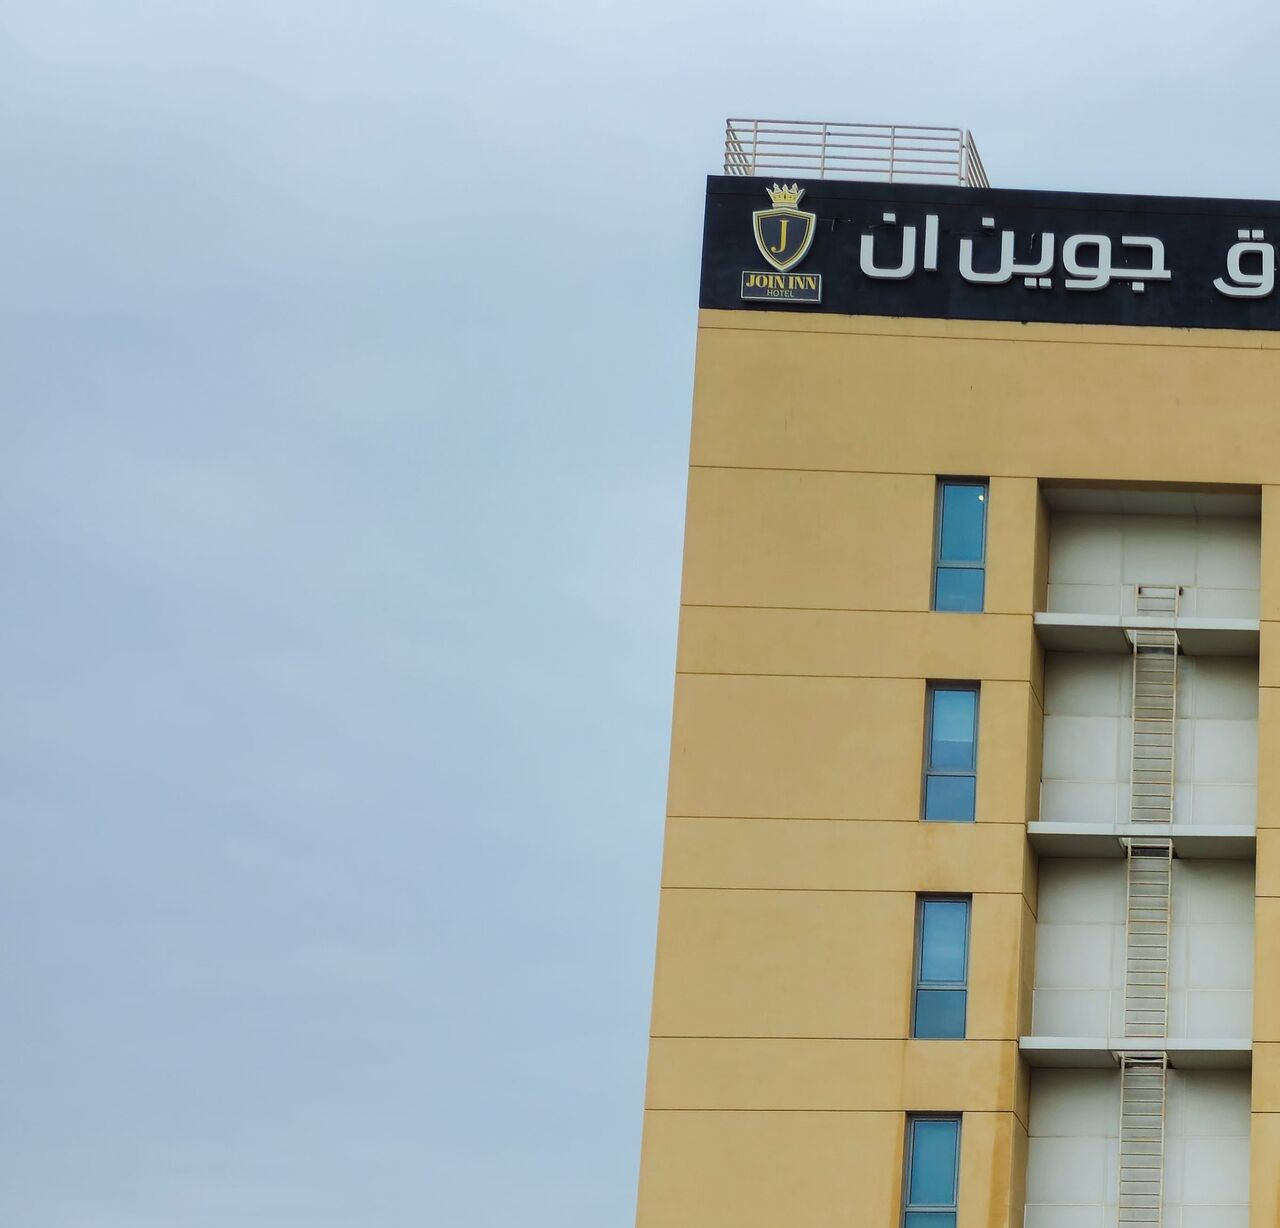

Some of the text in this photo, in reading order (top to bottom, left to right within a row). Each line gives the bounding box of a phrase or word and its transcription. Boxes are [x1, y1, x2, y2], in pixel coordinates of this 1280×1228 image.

[770, 219, 788, 253] J
[858, 211, 940, 280] ان
[956, 217, 1173, 293] جوين
[746, 274, 817, 290] JOIN INN
[766, 289, 795, 298] HOTEL
